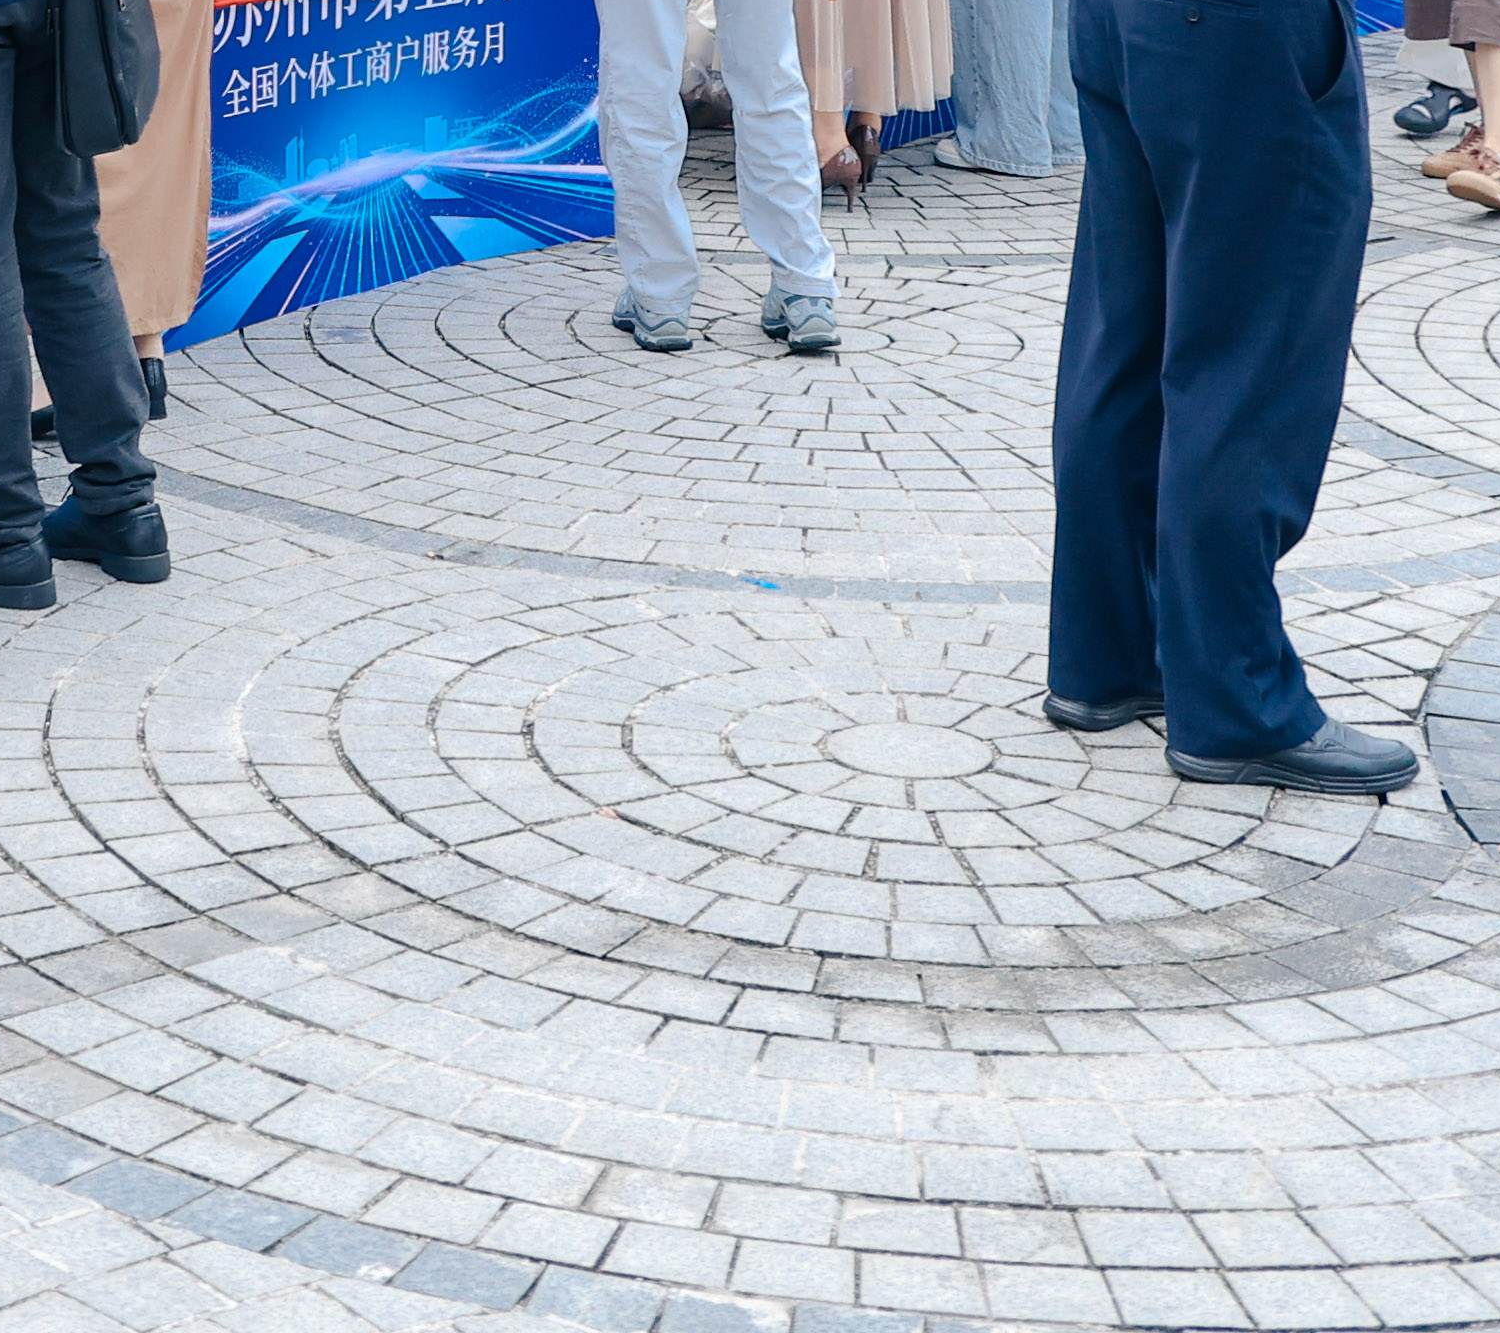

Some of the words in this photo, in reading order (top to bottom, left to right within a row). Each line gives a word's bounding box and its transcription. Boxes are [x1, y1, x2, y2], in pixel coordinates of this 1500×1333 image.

[221, 22, 506, 119] 全国个体工商户服务月
